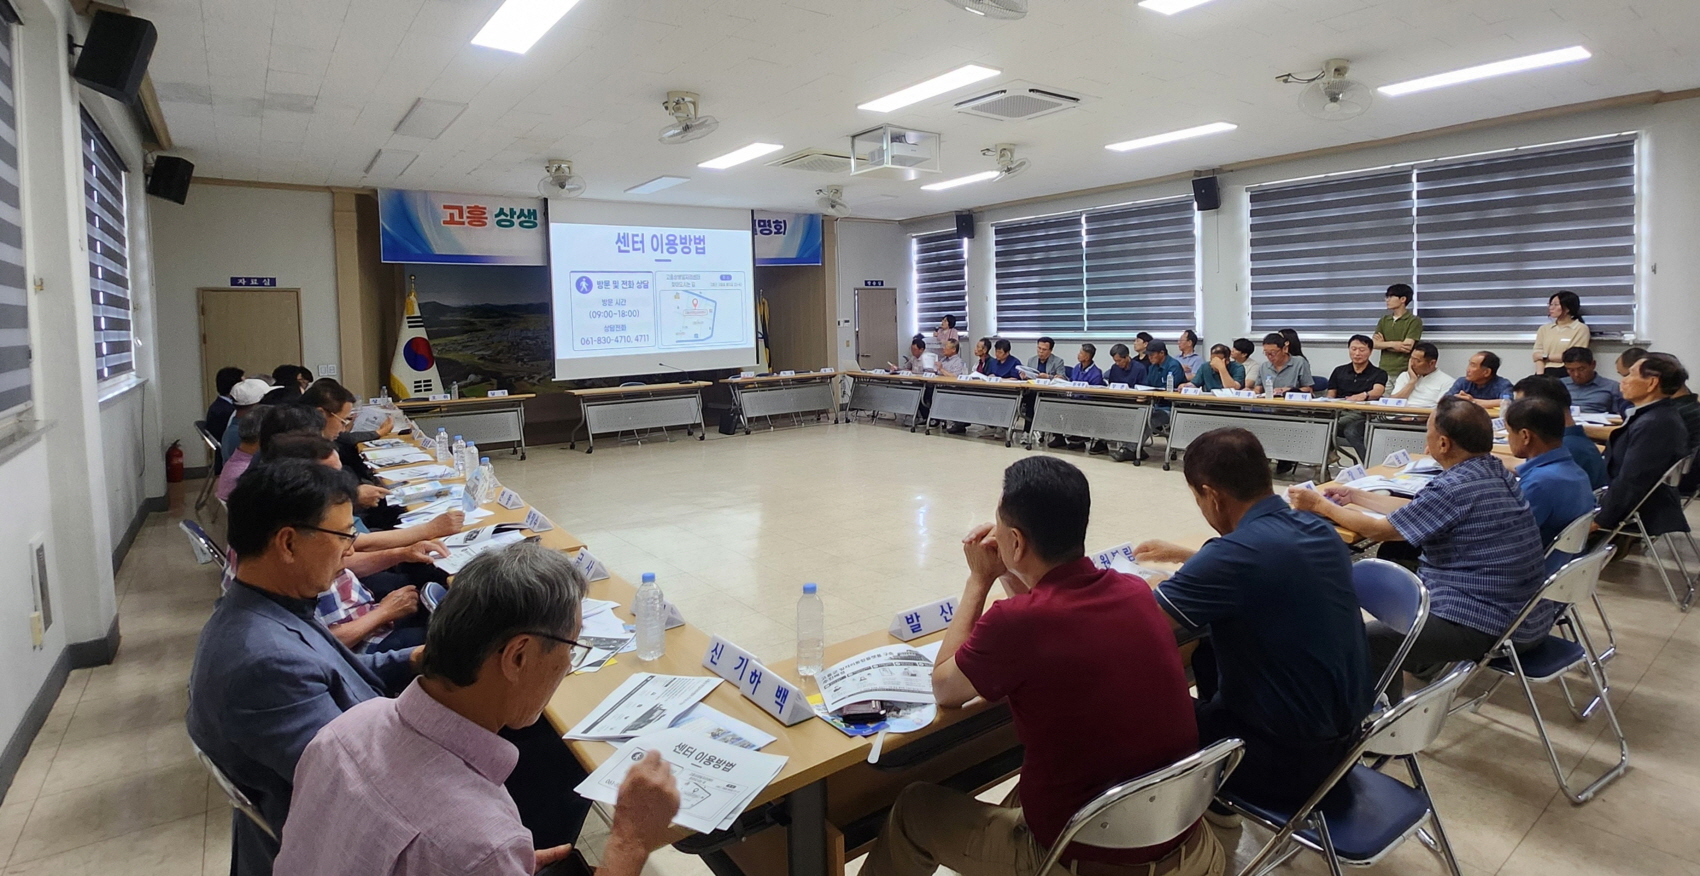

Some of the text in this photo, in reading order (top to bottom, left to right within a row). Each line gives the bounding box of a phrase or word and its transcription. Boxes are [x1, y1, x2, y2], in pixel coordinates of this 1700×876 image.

[442, 204, 538, 229] 고흥 상생
[754, 219, 787, 236] 명회
[615, 232, 706, 255] 센터 이용방법
[237, 278, 271, 286] 자료실
[596, 279, 650, 290] 방문 및 전화 상담
[601, 299, 613, 307] 방문
[604, 324, 627, 332] 상담전화
[635, 334, 650, 343] 4711
[673, 742, 737, 772] 센터 이용방법
